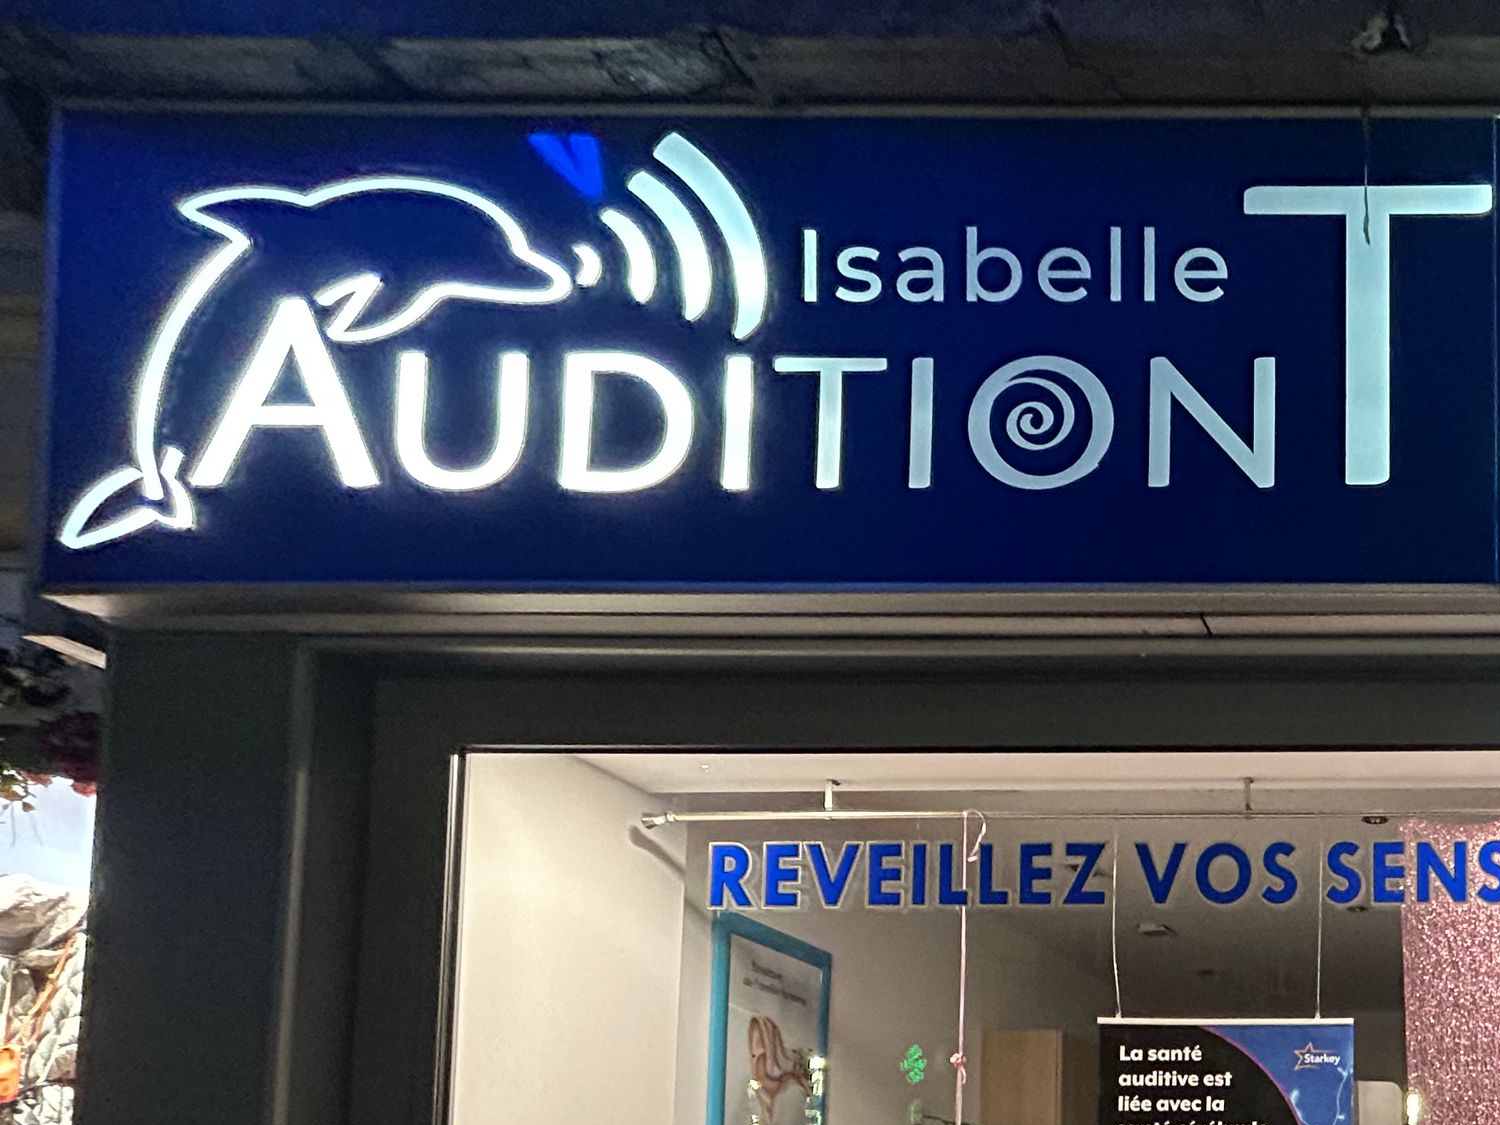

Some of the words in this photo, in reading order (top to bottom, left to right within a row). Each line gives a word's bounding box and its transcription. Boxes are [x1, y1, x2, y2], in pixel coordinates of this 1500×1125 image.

[802, 228, 1228, 305] Isabelle
[190, 299, 1276, 491] AUDITION
[707, 840, 1108, 909] REVEILLEZ
[1134, 840, 1299, 907] VOS
[1119, 1045, 1143, 1062] La
[1147, 1045, 1203, 1062] santé
[1303, 1053, 1341, 1066] Starkey
[1118, 1070, 1199, 1087] auditive
[1203, 1071, 1233, 1087] est
[1117, 1095, 1152, 1112] liée
[1156, 1097, 1202, 1112] avec
[1205, 1095, 1225, 1112] la
